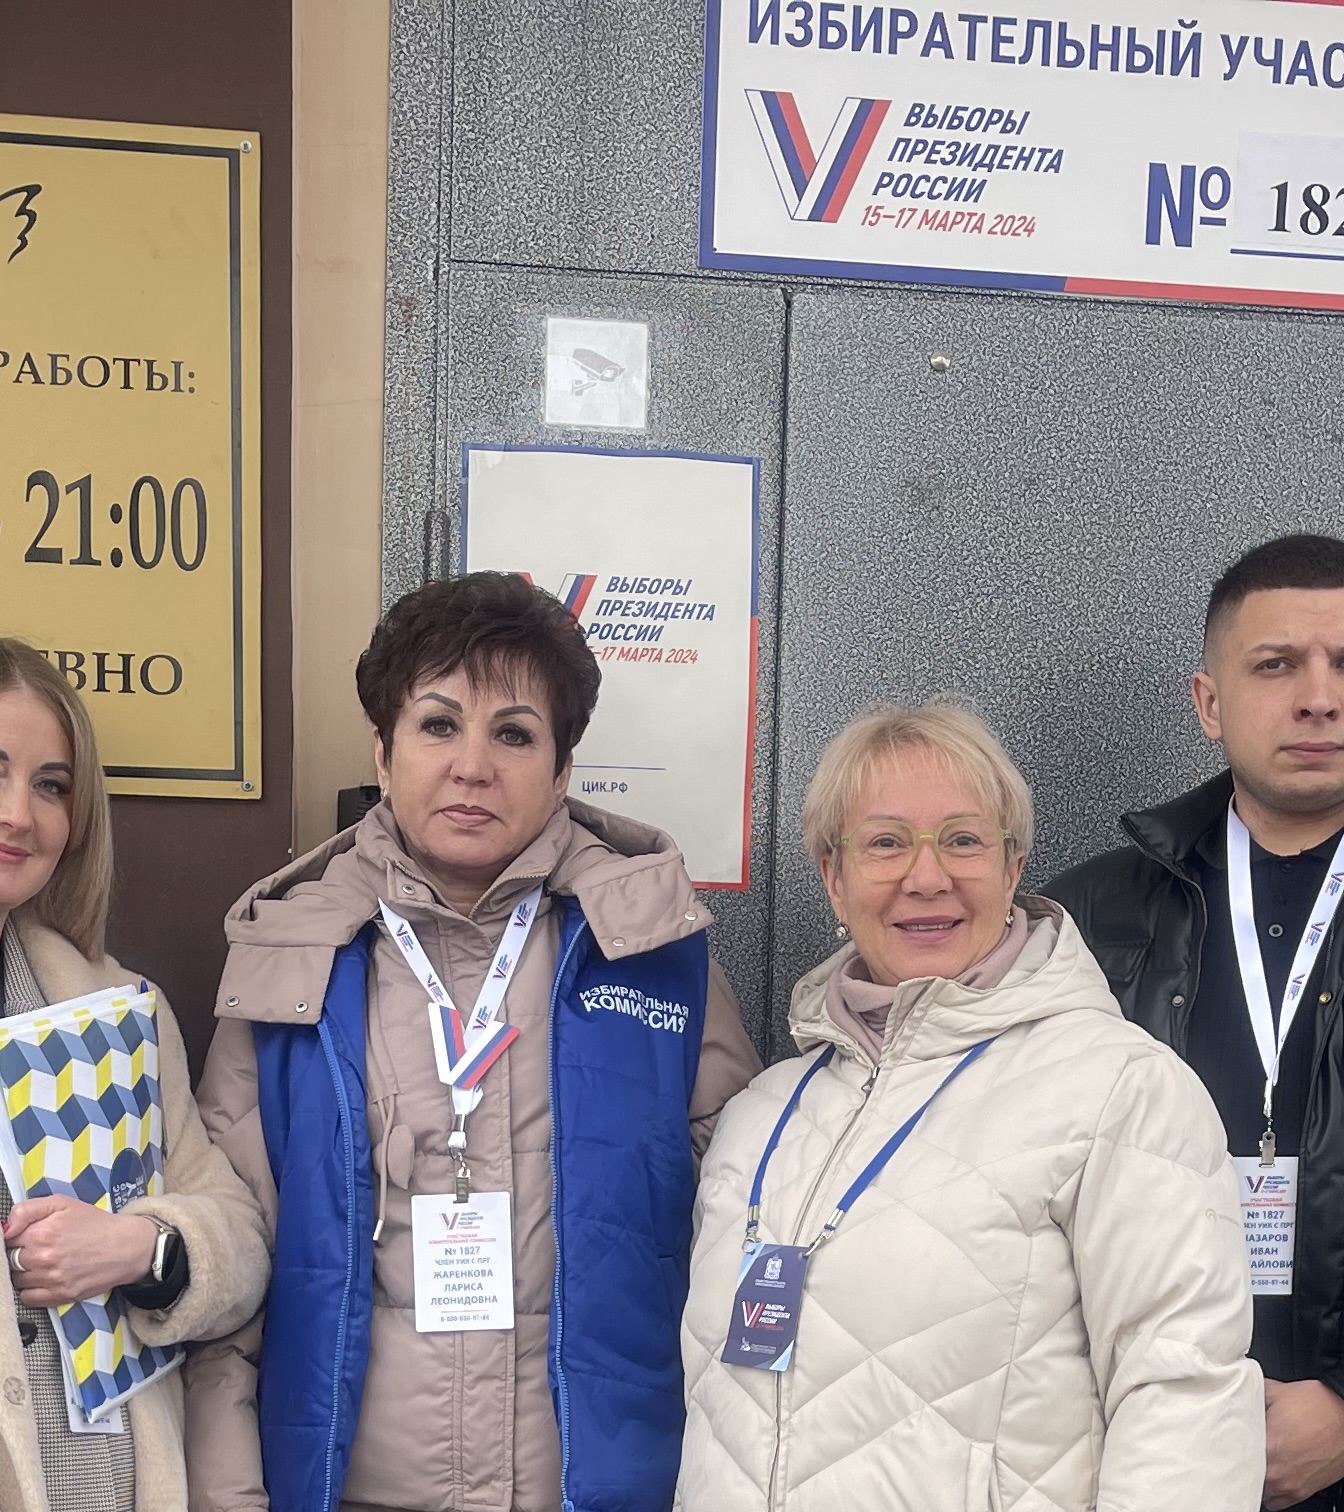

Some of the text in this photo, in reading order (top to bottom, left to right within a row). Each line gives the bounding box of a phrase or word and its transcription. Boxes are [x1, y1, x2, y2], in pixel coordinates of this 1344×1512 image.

[748, 0, 1203, 78] ИЗБИРАТЕЛЬНЫЙ
[903, 102, 1031, 135] ВЫБОРЫ
[887, 137, 1065, 174] ПРЕЗИДЕНТА
[872, 171, 988, 203] РОССИИ
[917, 208, 986, 234] МАРТА
[987, 213, 1037, 238] 2024
[24, 469, 208, 572] 21:00
[606, 576, 692, 596] ВЫБОРЫ
[595, 599, 715, 621] ПРЕЗИДЕНТА
[586, 622, 664, 642] РОССИИ
[616, 647, 663, 663] МАРТА
[664, 648, 698, 664] 2024
[582, 780, 628, 794] ЦИК.РФ
[1262, 1210, 1285, 1219] 1827
[1246, 1233, 1288, 1242] АЗАРОВ
[459, 1246, 480, 1255] 1827
[1250, 1247, 1278, 1255] ИВАН
[433, 1269, 493, 1279] ЖАРЕНКОВА
[444, 1283, 483, 1292] ЛАРИСА
[430, 1295, 498, 1306] ЛЕОНИДОВНА
